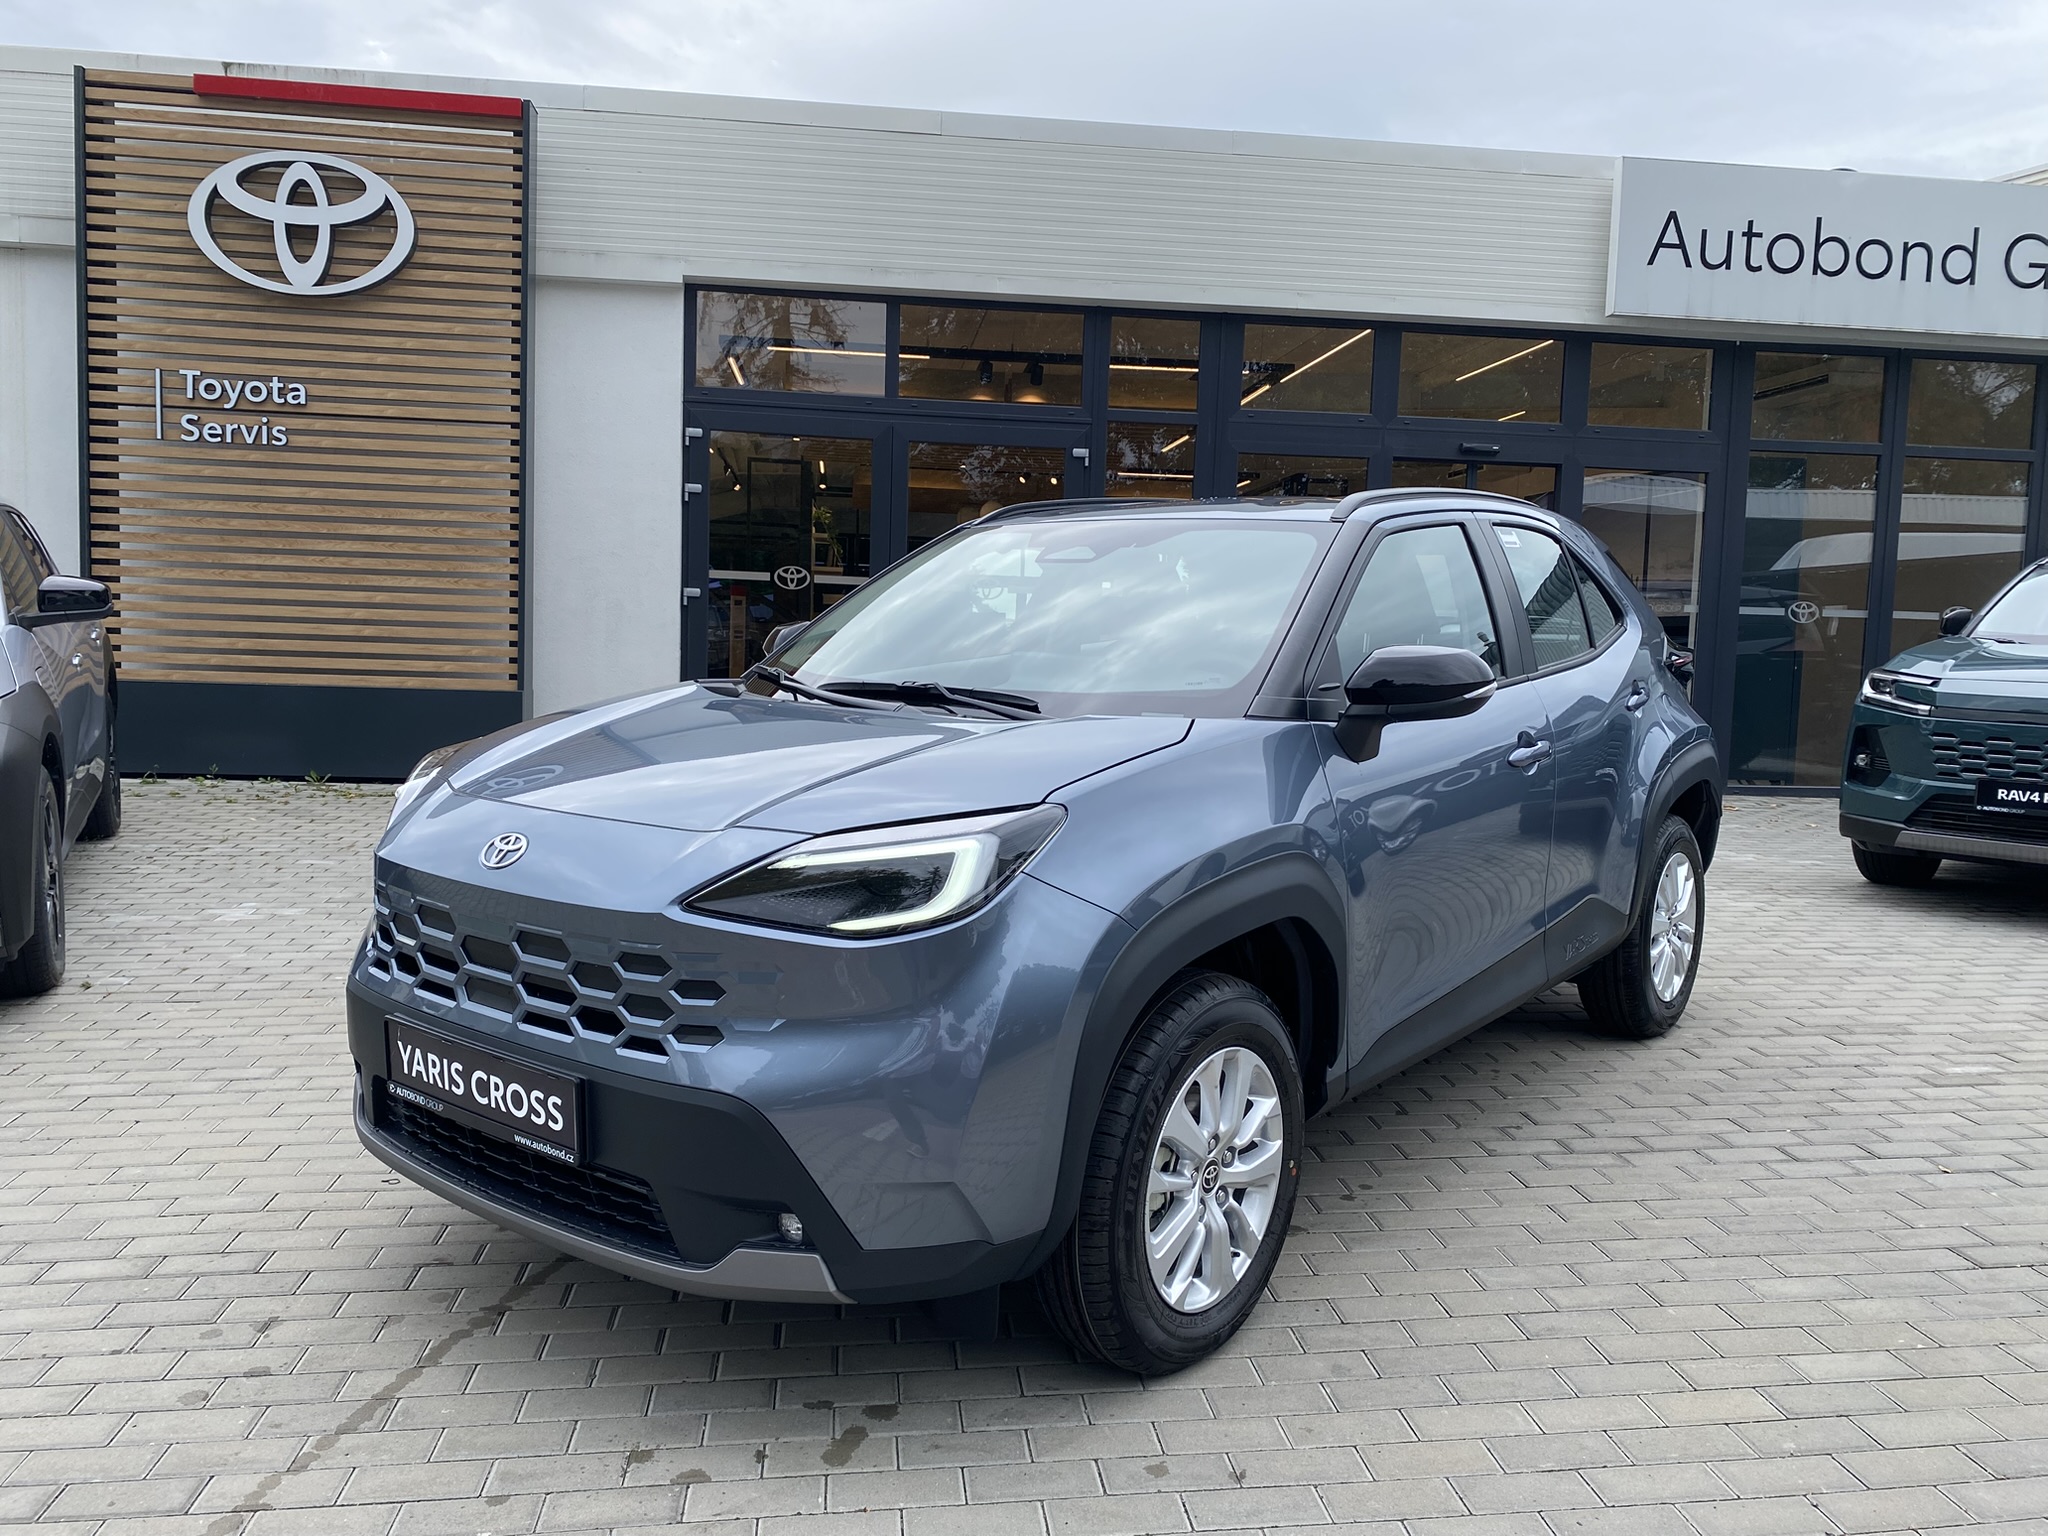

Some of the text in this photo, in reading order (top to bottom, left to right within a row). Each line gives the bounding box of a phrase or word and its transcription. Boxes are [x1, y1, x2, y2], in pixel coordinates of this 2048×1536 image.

[1647, 210, 1980, 286] Autobond
[179, 369, 307, 409] Toyota
[180, 414, 288, 446] Servis
[1998, 789, 2041, 803] RAV4
[396, 1086, 444, 1112] AUTOBOND GROUP
[397, 1040, 564, 1132] YARIS CROSS
[514, 1134, 575, 1163] www.autobond.cz
